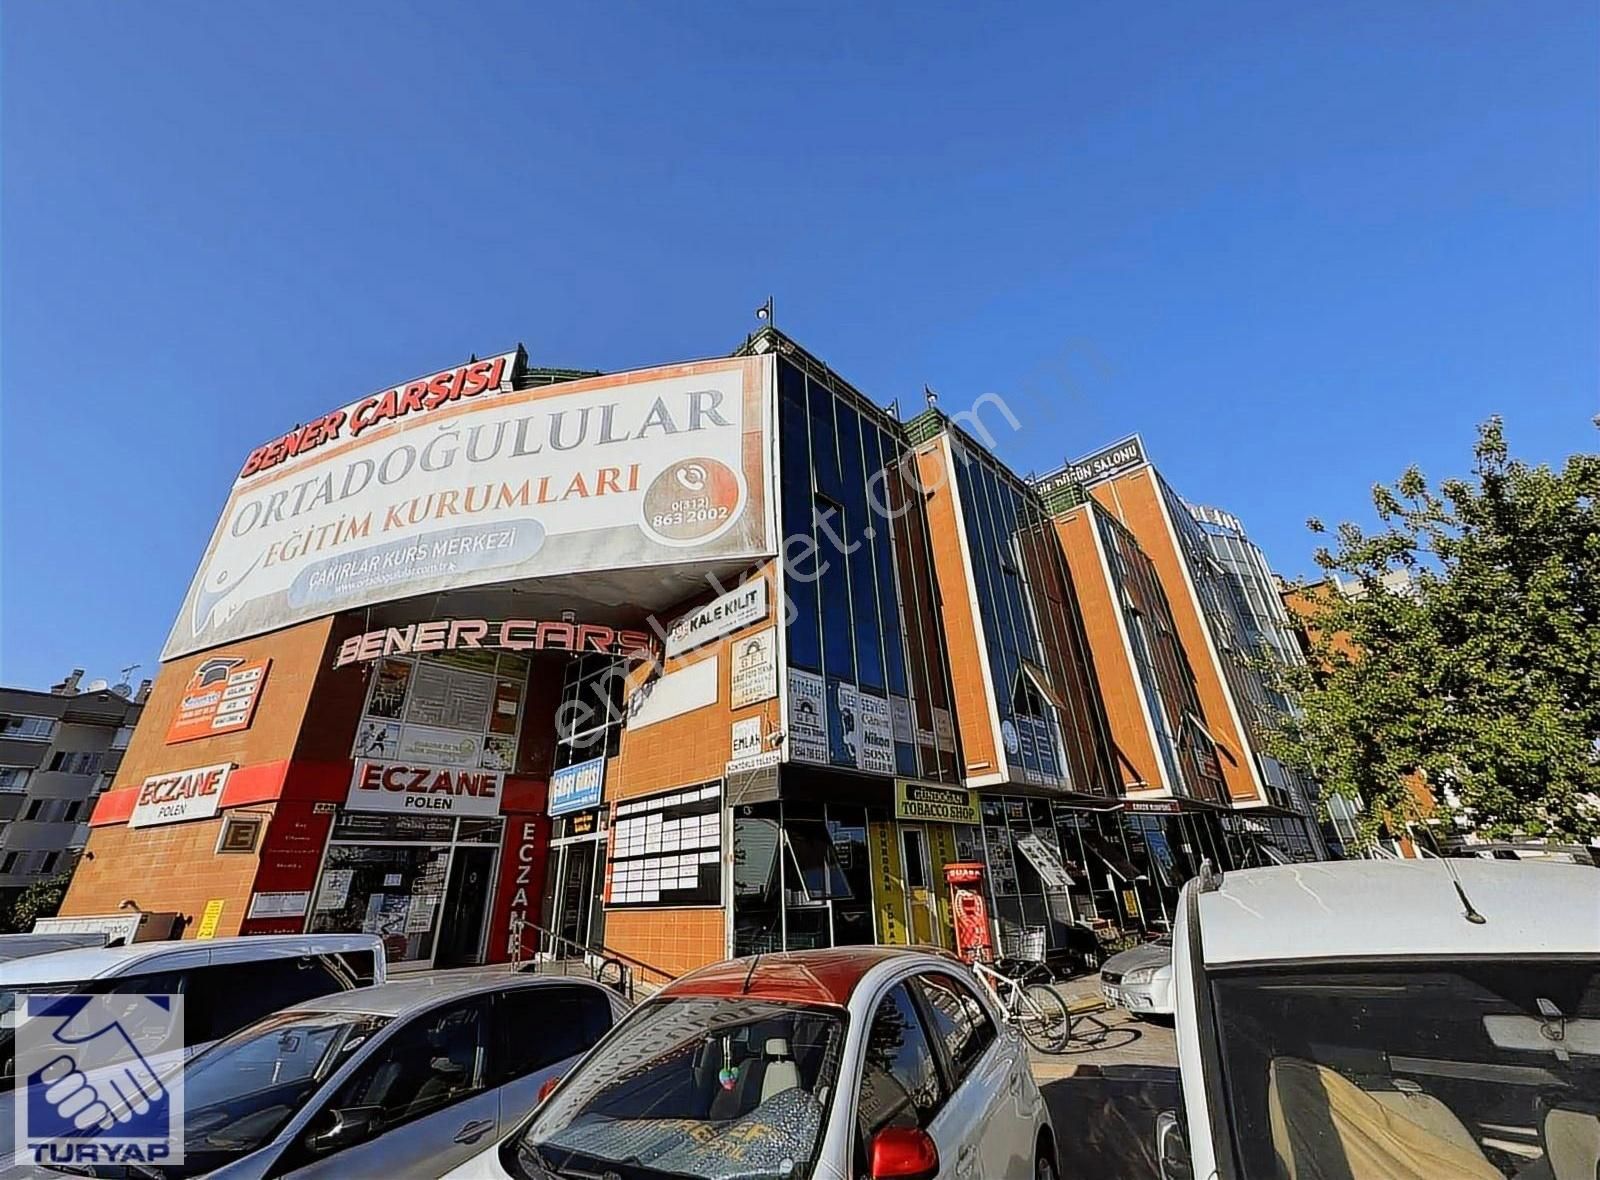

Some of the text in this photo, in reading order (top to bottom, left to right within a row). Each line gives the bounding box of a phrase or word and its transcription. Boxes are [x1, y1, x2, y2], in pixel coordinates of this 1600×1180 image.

[241, 358, 506, 478] BENER ÇARŞISI
[231, 389, 732, 539] ORTADOĞULULAR
[1094, 445, 1138, 473] SALONU
[263, 463, 641, 568] EĞİTİM KURUMLARI
[653, 505, 729, 529] 863 2002
[308, 527, 518, 591] ÇAKIRLAR KURS MERKEZİ
[690, 606, 722, 632] KALE
[337, 619, 488, 667] BENER
[864, 731, 890, 748] Nikon
[864, 749, 893, 762] SONY
[139, 768, 224, 806] ECZANE
[359, 762, 499, 798] ECZANE
[405, 796, 452, 809] POLEN
[914, 787, 963, 804] GÜNDOĞAN
[157, 804, 187, 818] POLEN
[902, 801, 976, 819] TOBACCO SHOP
